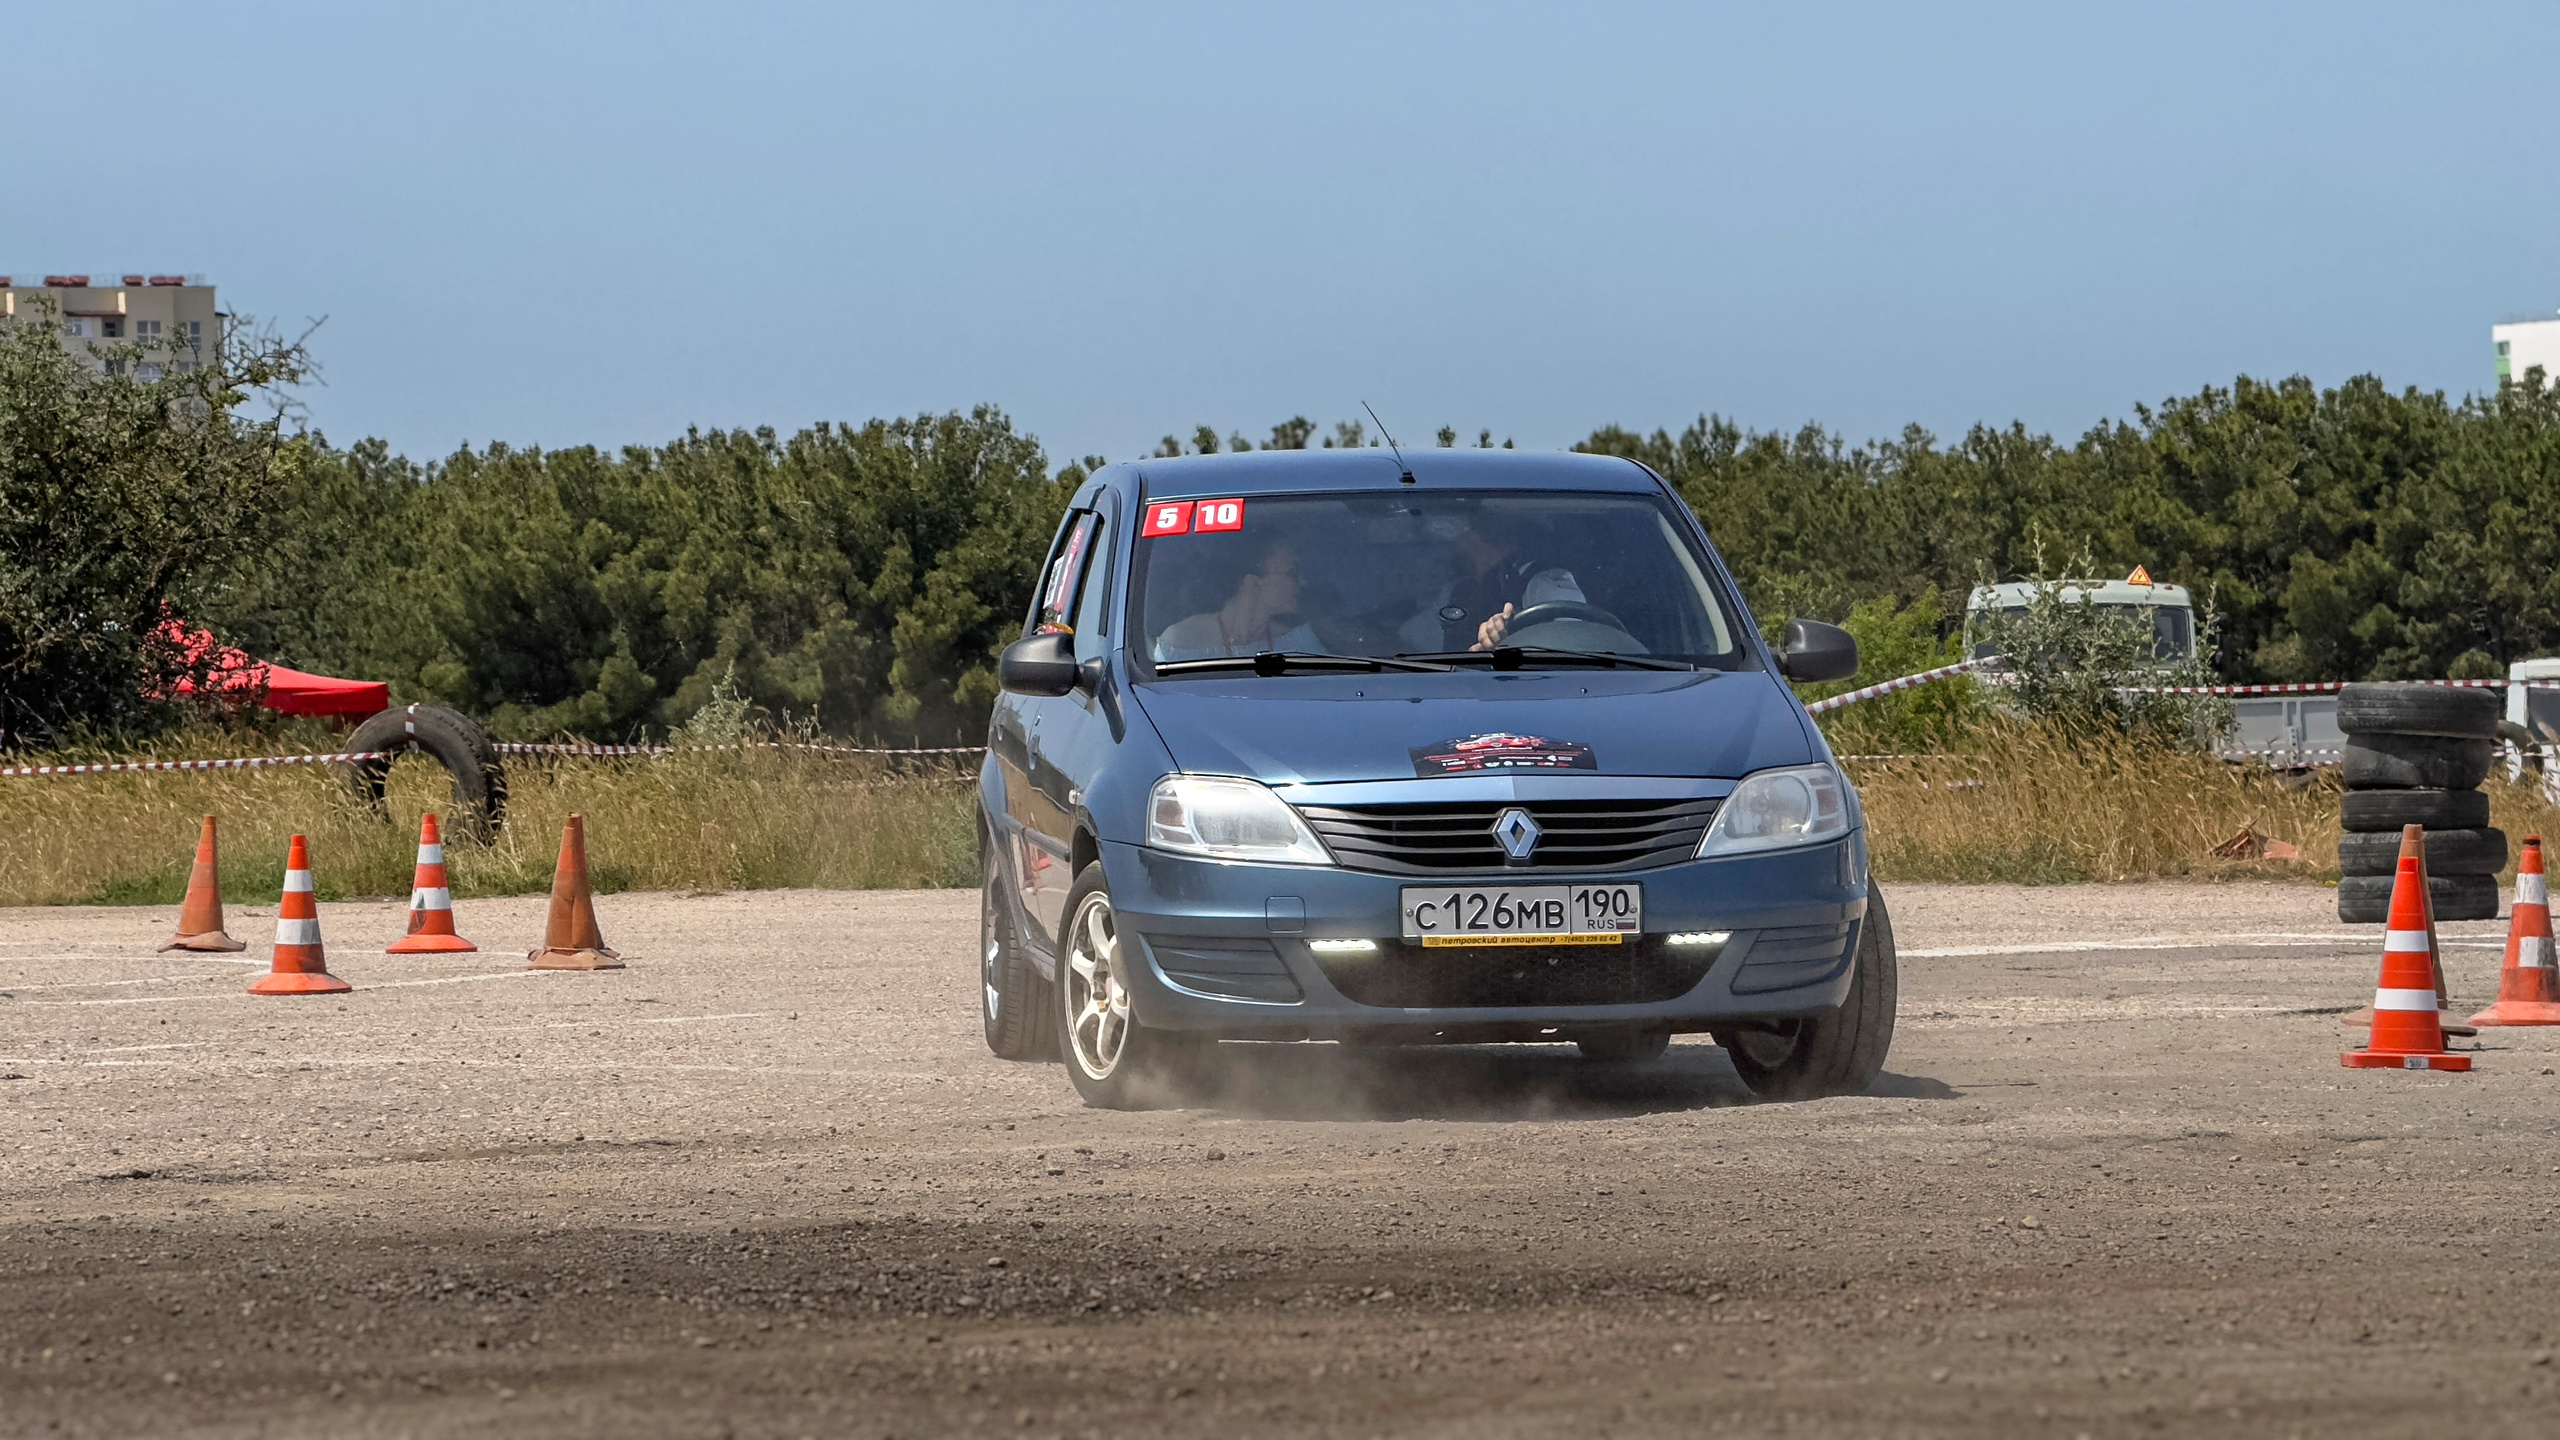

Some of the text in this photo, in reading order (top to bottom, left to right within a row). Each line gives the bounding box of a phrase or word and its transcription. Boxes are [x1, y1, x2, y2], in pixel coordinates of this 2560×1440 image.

[1156, 507, 1178, 529] 5
[1201, 503, 1238, 525] 10
[1574, 888, 1630, 918] 190
[1587, 919, 1615, 930] RUS
[1441, 936, 1498, 946] петровский
[1500, 935, 1556, 944] автоцентр
